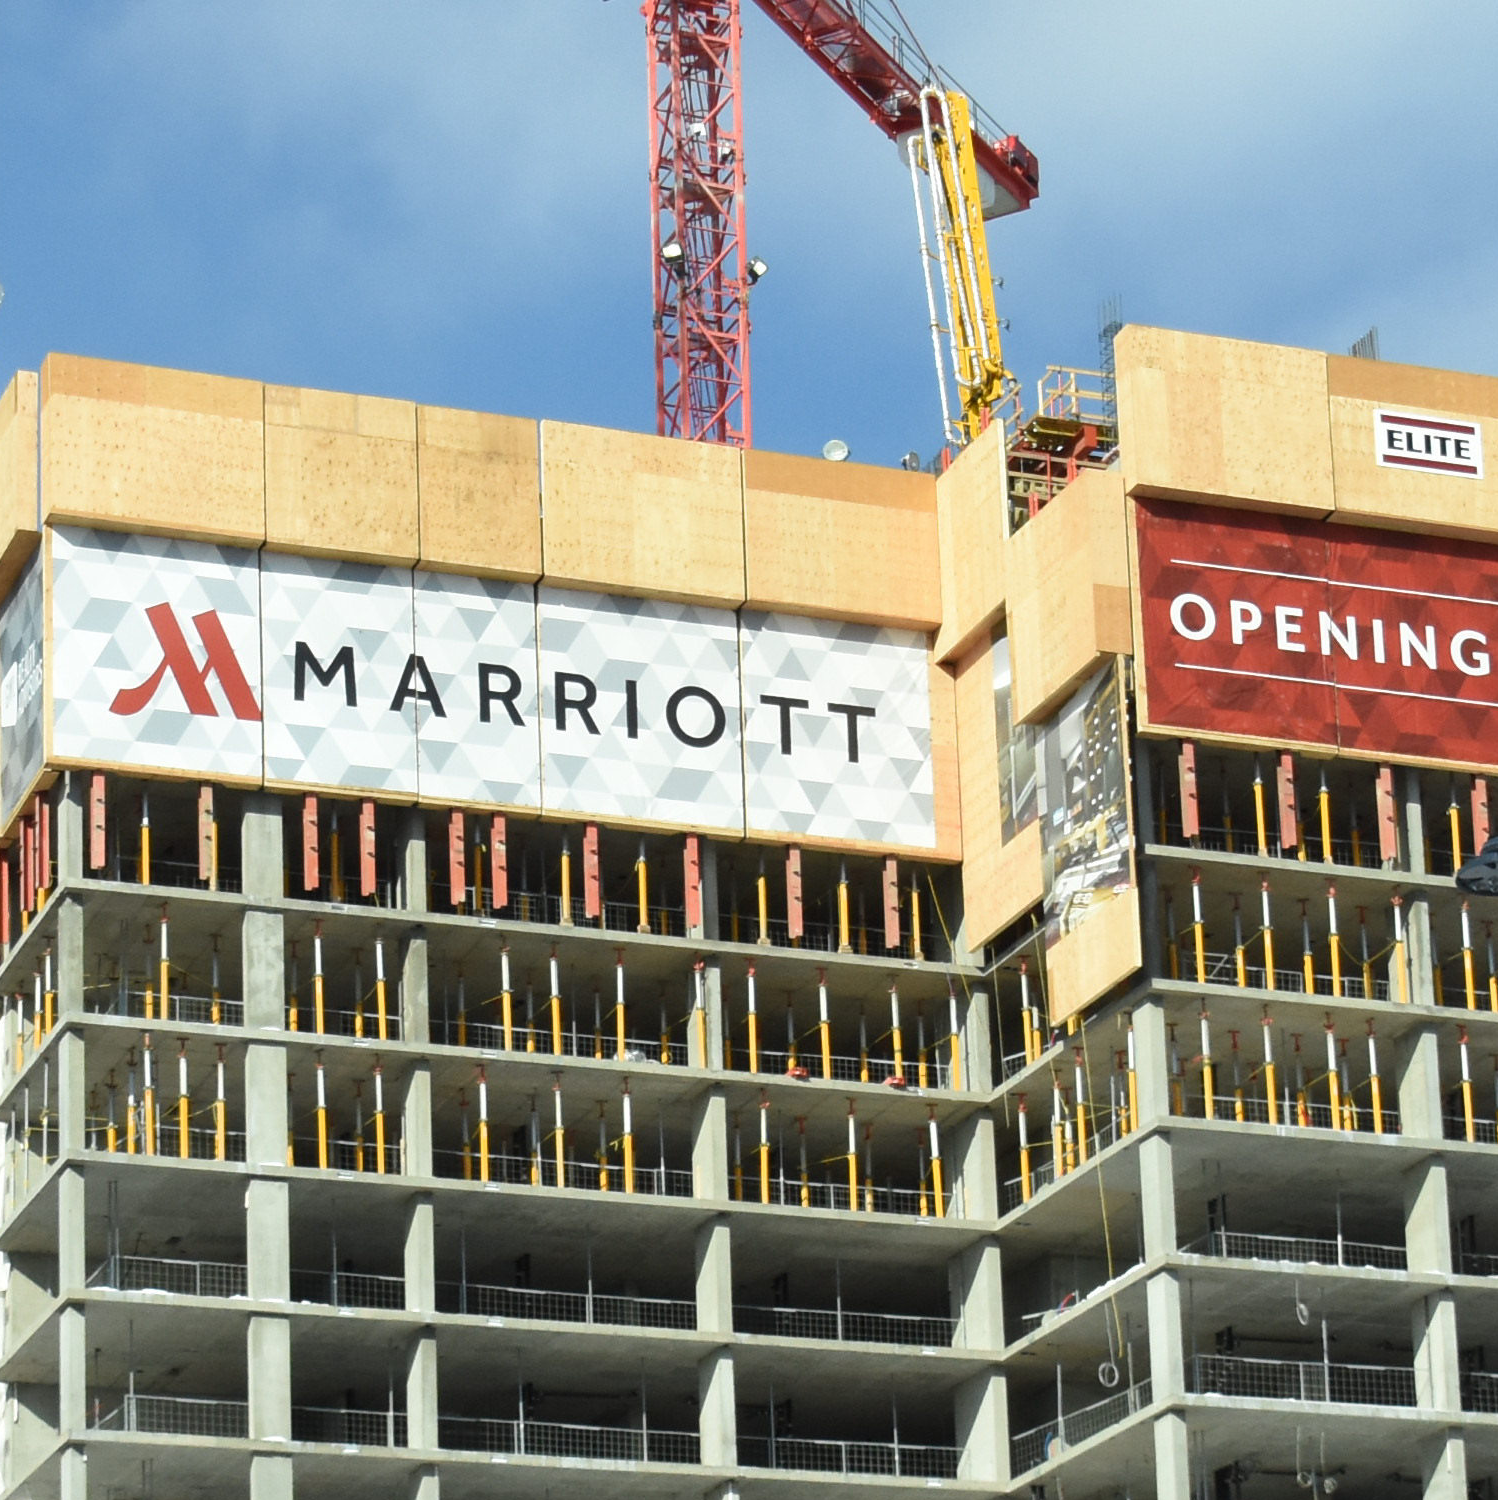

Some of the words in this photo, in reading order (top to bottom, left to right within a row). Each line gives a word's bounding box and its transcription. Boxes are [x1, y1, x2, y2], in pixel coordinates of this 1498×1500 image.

[1387, 429, 1471, 460] ELITE
[1170, 594, 1491, 678] OPENING
[294, 640, 876, 764] MARRIOTT
